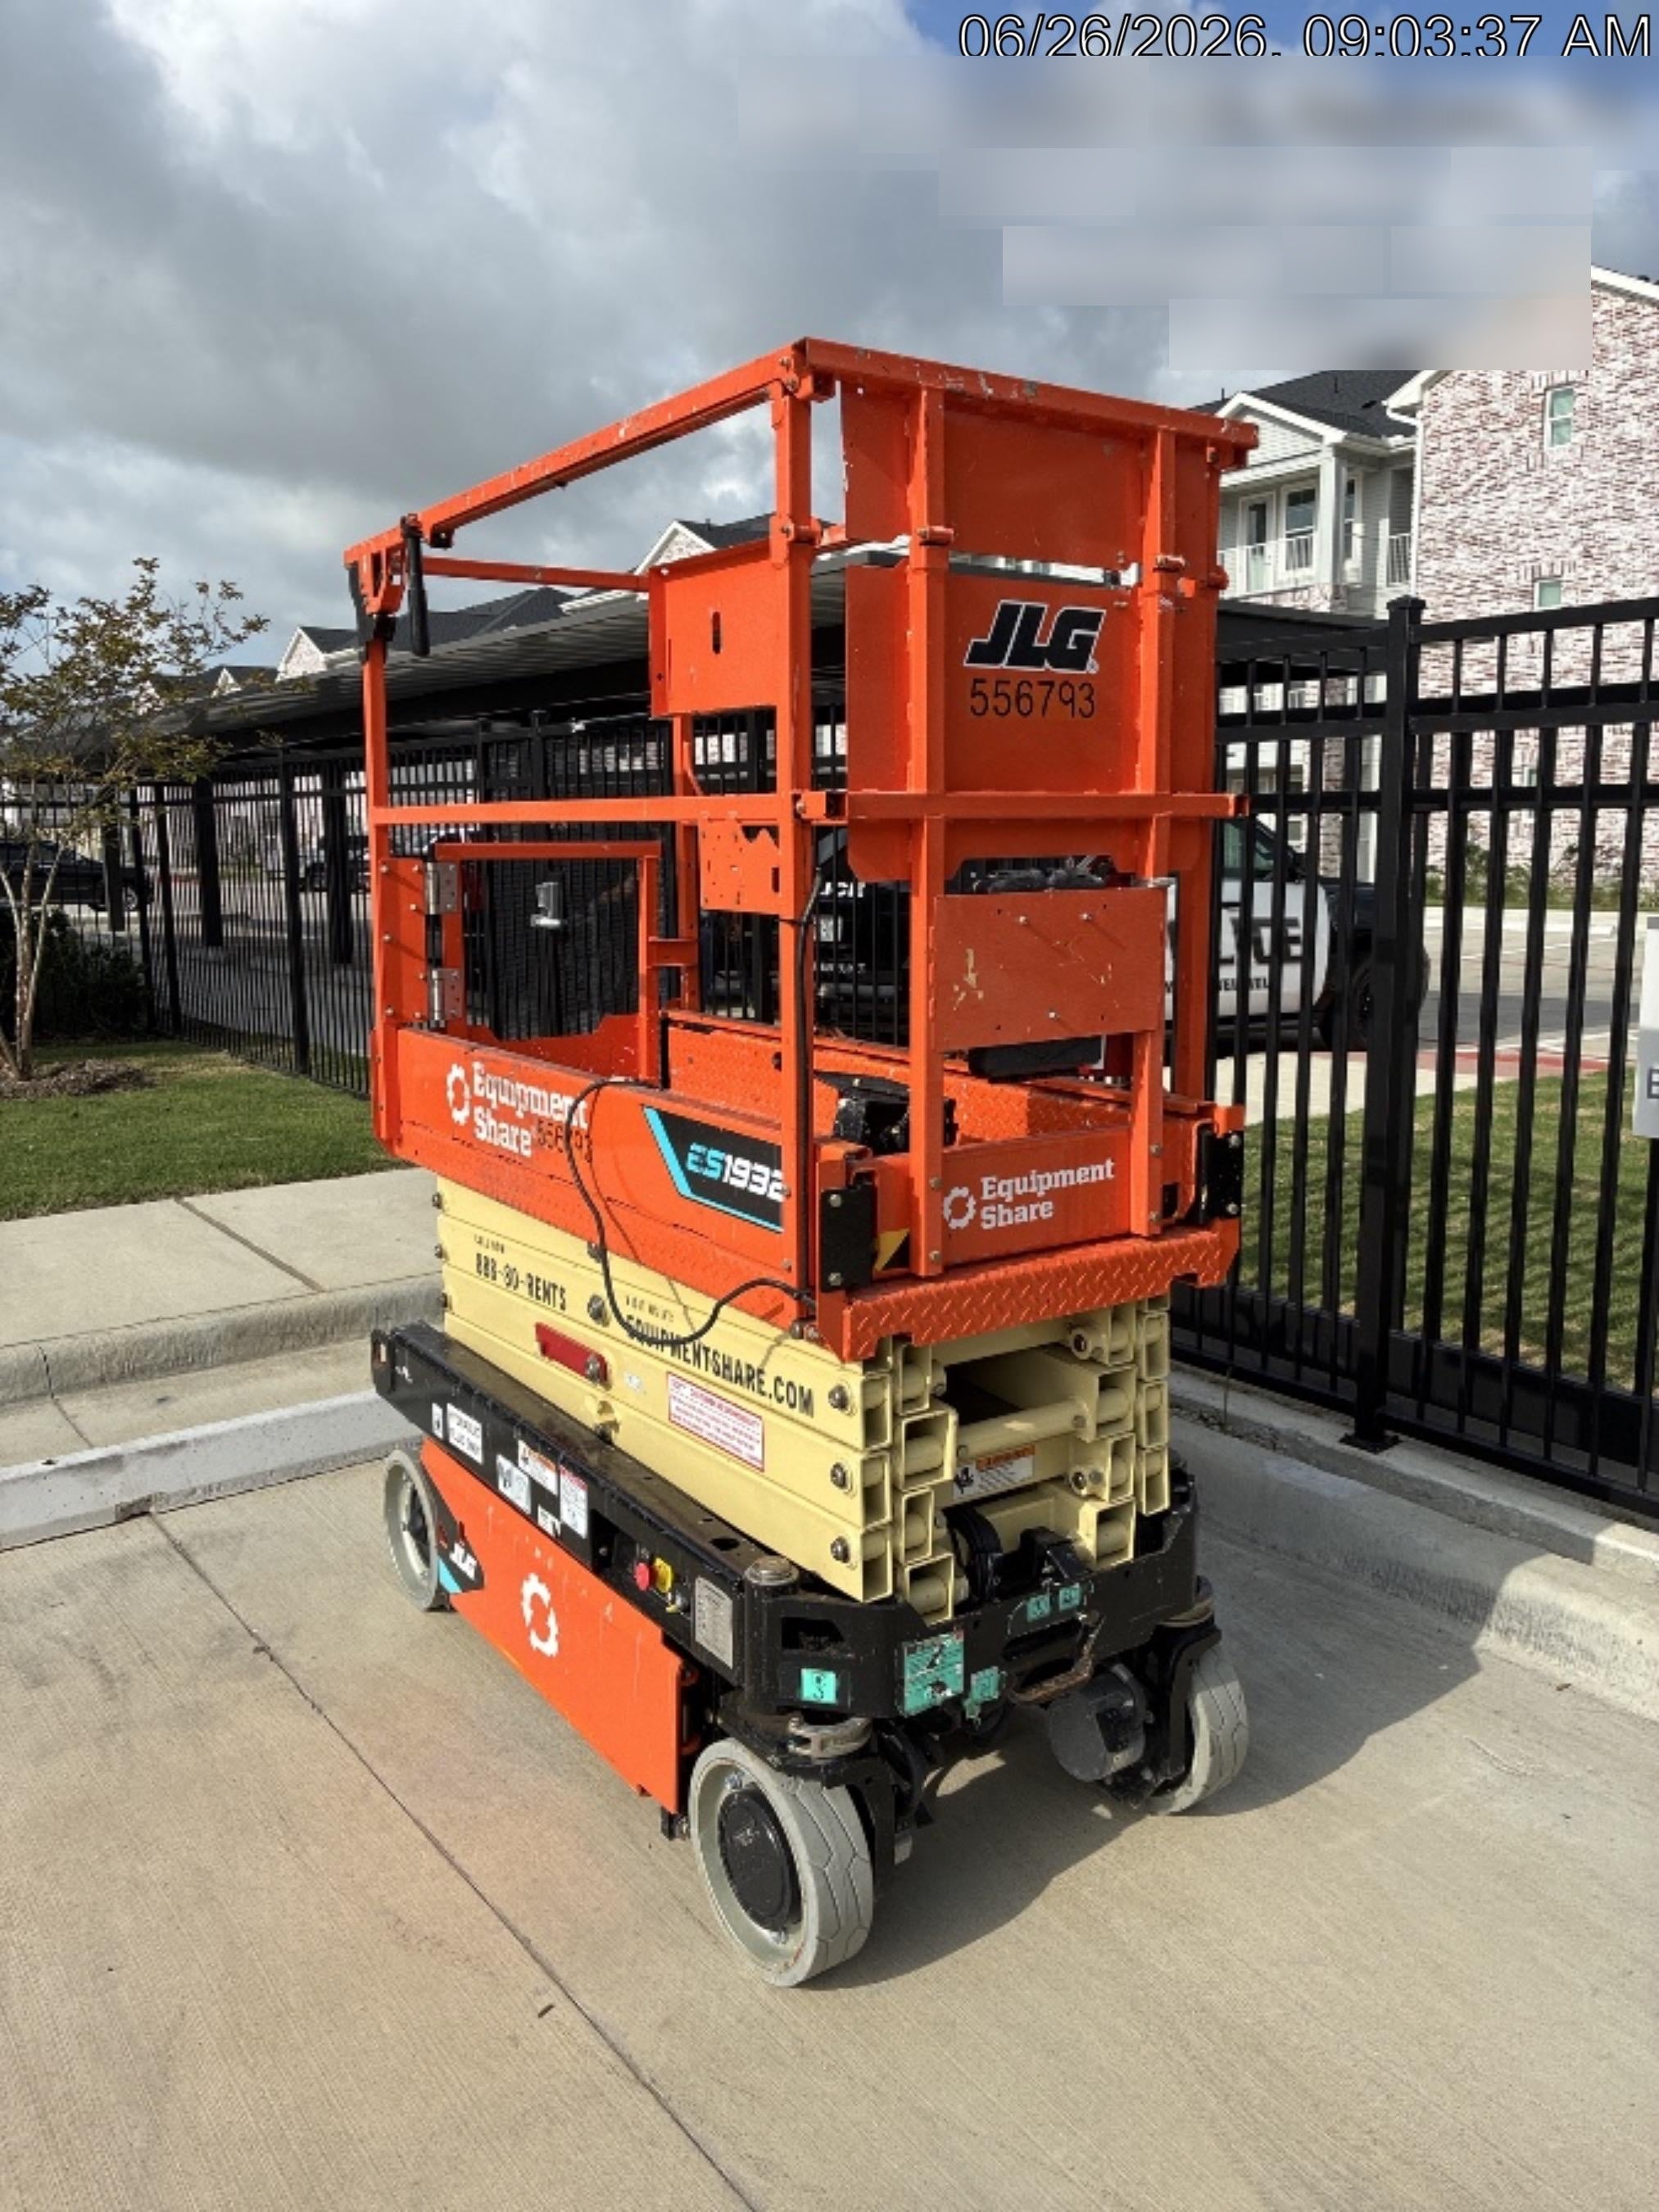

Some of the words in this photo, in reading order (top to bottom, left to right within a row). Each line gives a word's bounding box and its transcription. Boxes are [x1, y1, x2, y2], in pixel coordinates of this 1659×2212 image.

[963, 599, 1107, 674] JLG
[970, 678, 1095, 718] 556793
[472, 1061, 588, 1130] Equipment
[473, 1105, 533, 1158] Share
[981, 1158, 1115, 1202] Equipment
[980, 1200, 1054, 1230] Share
